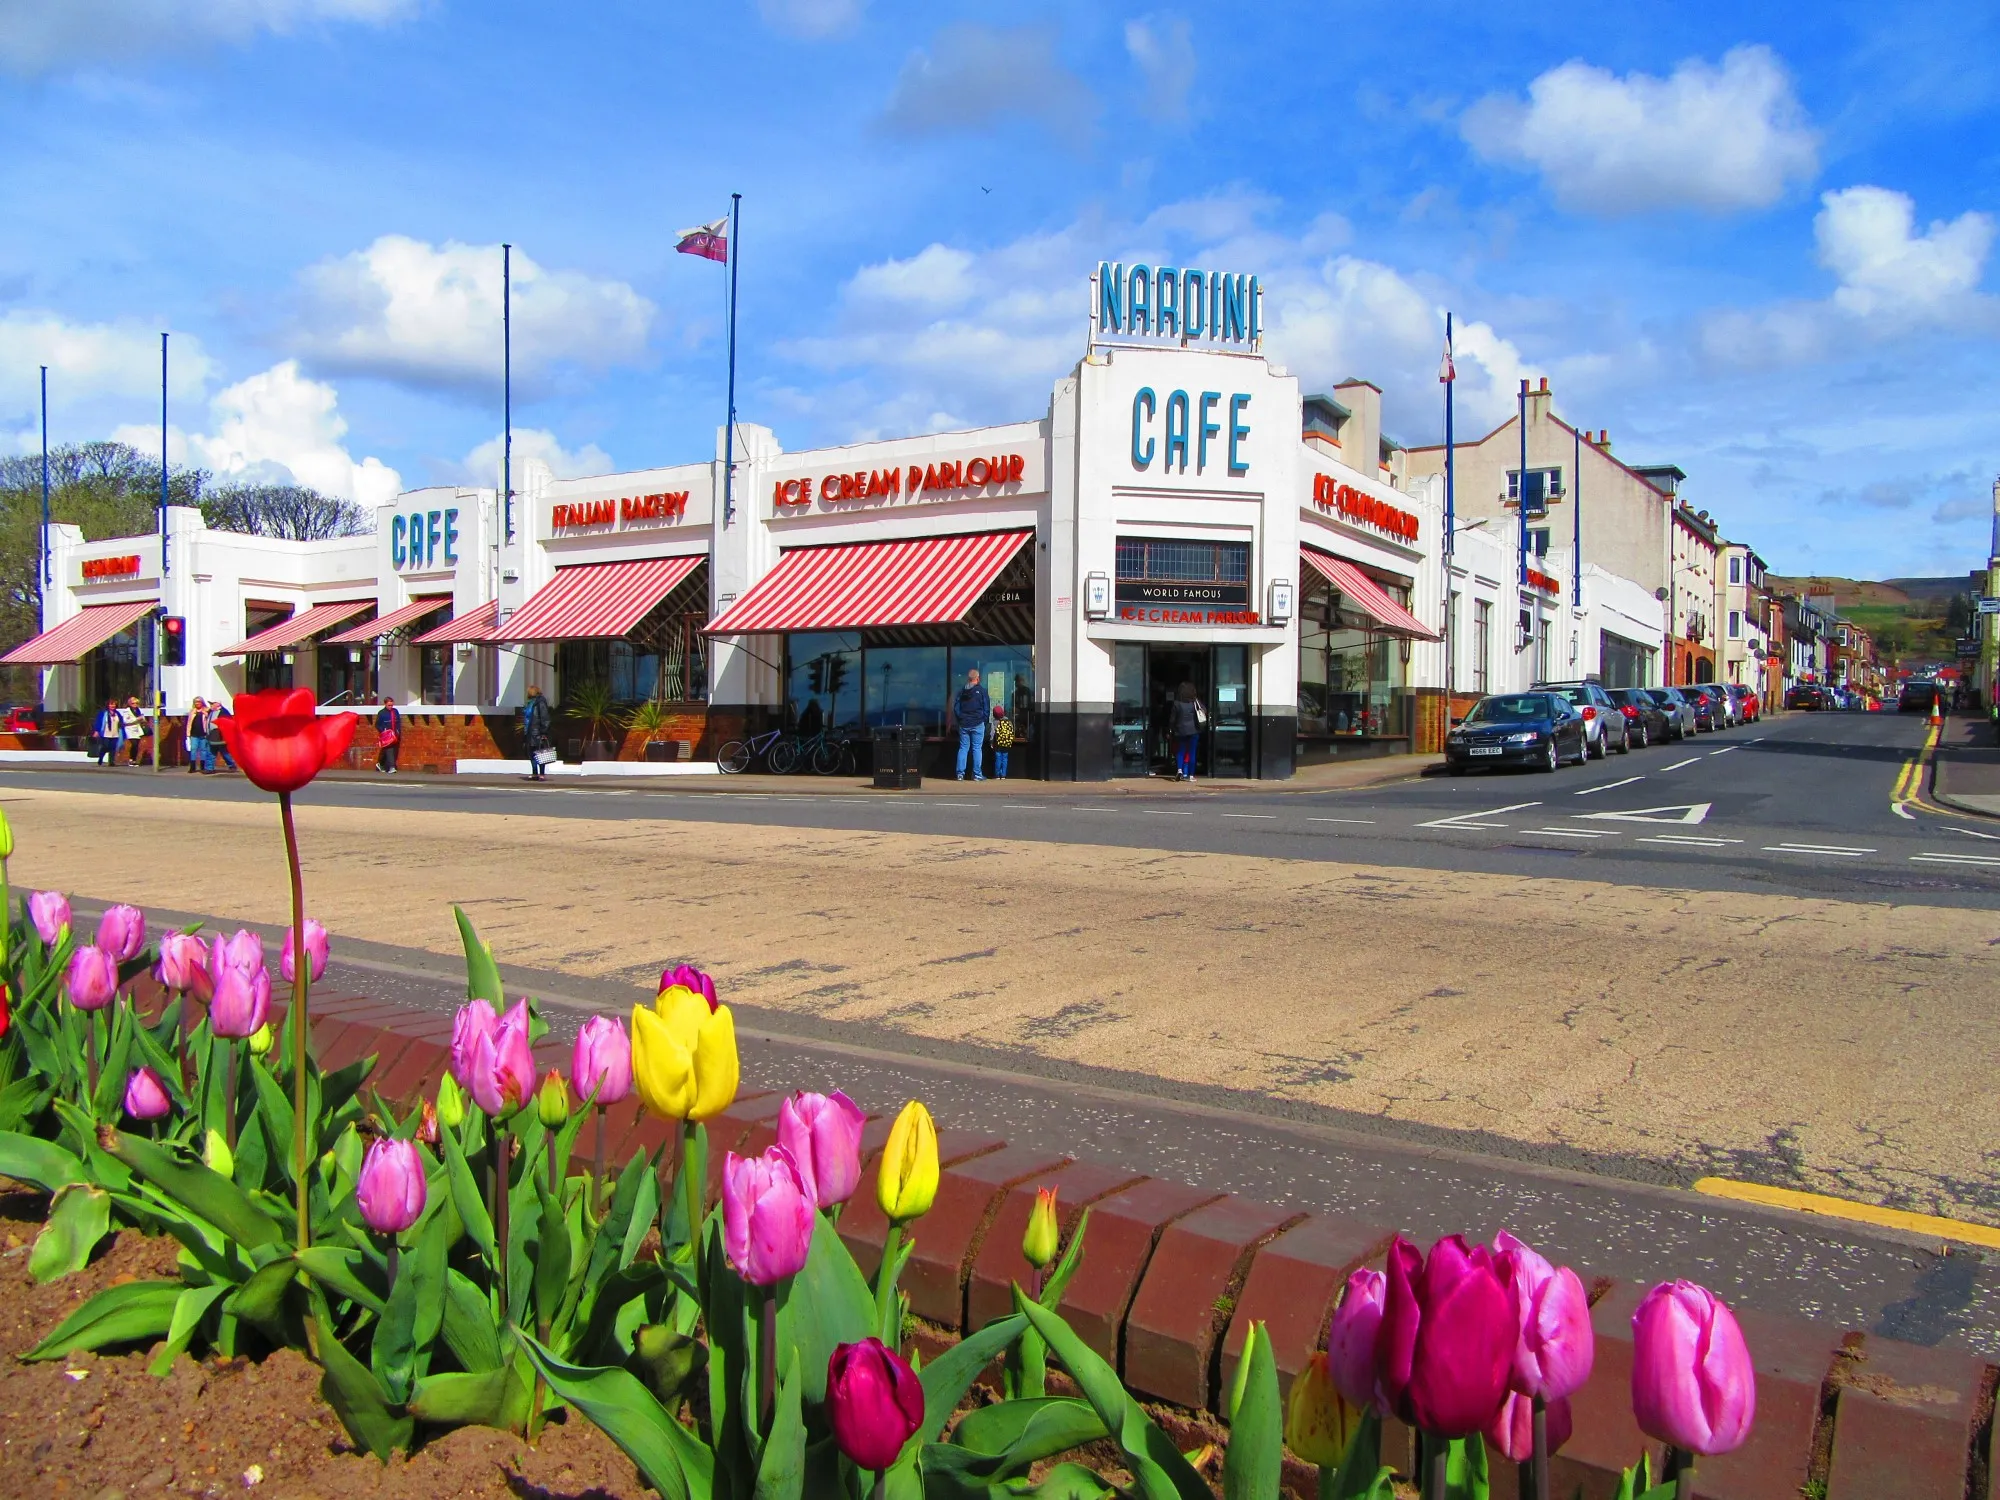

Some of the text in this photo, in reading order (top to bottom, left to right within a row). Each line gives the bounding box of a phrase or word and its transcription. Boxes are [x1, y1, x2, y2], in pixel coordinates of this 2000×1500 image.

[1097, 260, 1259, 343] NARDINI
[1133, 386, 1251, 473] CAFE
[775, 454, 1025, 507] ICE CREAM PARLOUR
[392, 508, 459, 563] CAFE
[552, 490, 690, 528] ITALIAN BAKERY
[1121, 605, 1260, 625] ICE CREAM PARLOUR
[1143, 587, 1221, 599] WORLD FAMOUS
